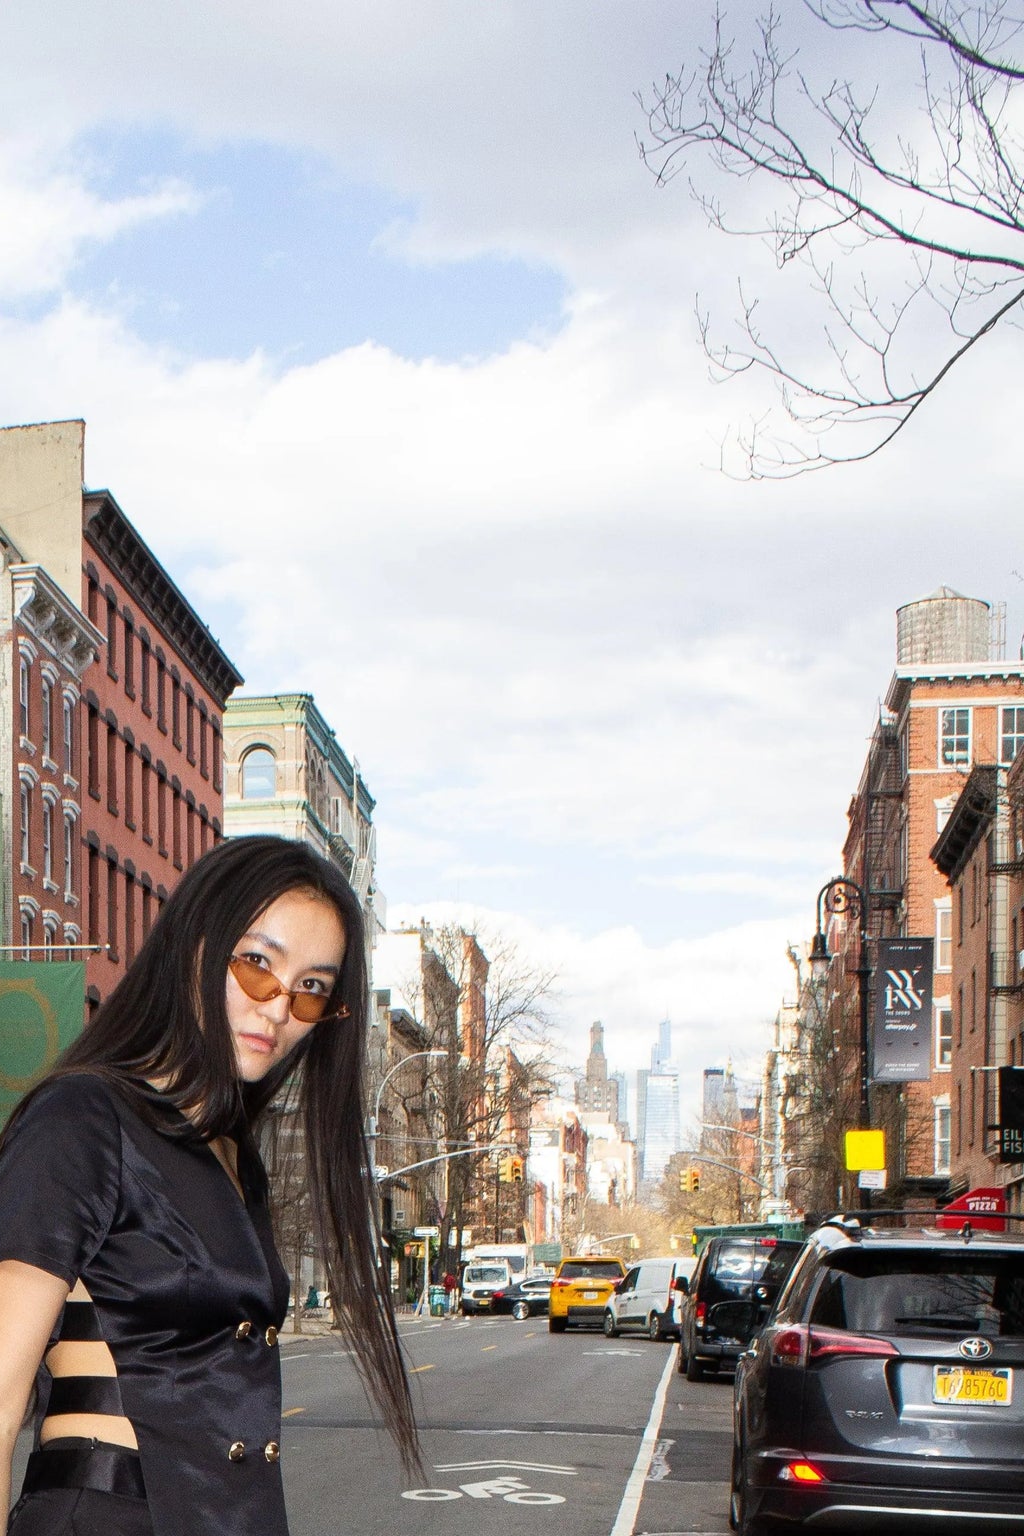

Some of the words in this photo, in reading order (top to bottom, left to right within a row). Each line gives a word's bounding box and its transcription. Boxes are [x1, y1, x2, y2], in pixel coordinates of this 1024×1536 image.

[1003, 1129, 1024, 1140] EIL
[1003, 1142, 1024, 1153] FIS
[969, 1201, 997, 1211] PIZZA
